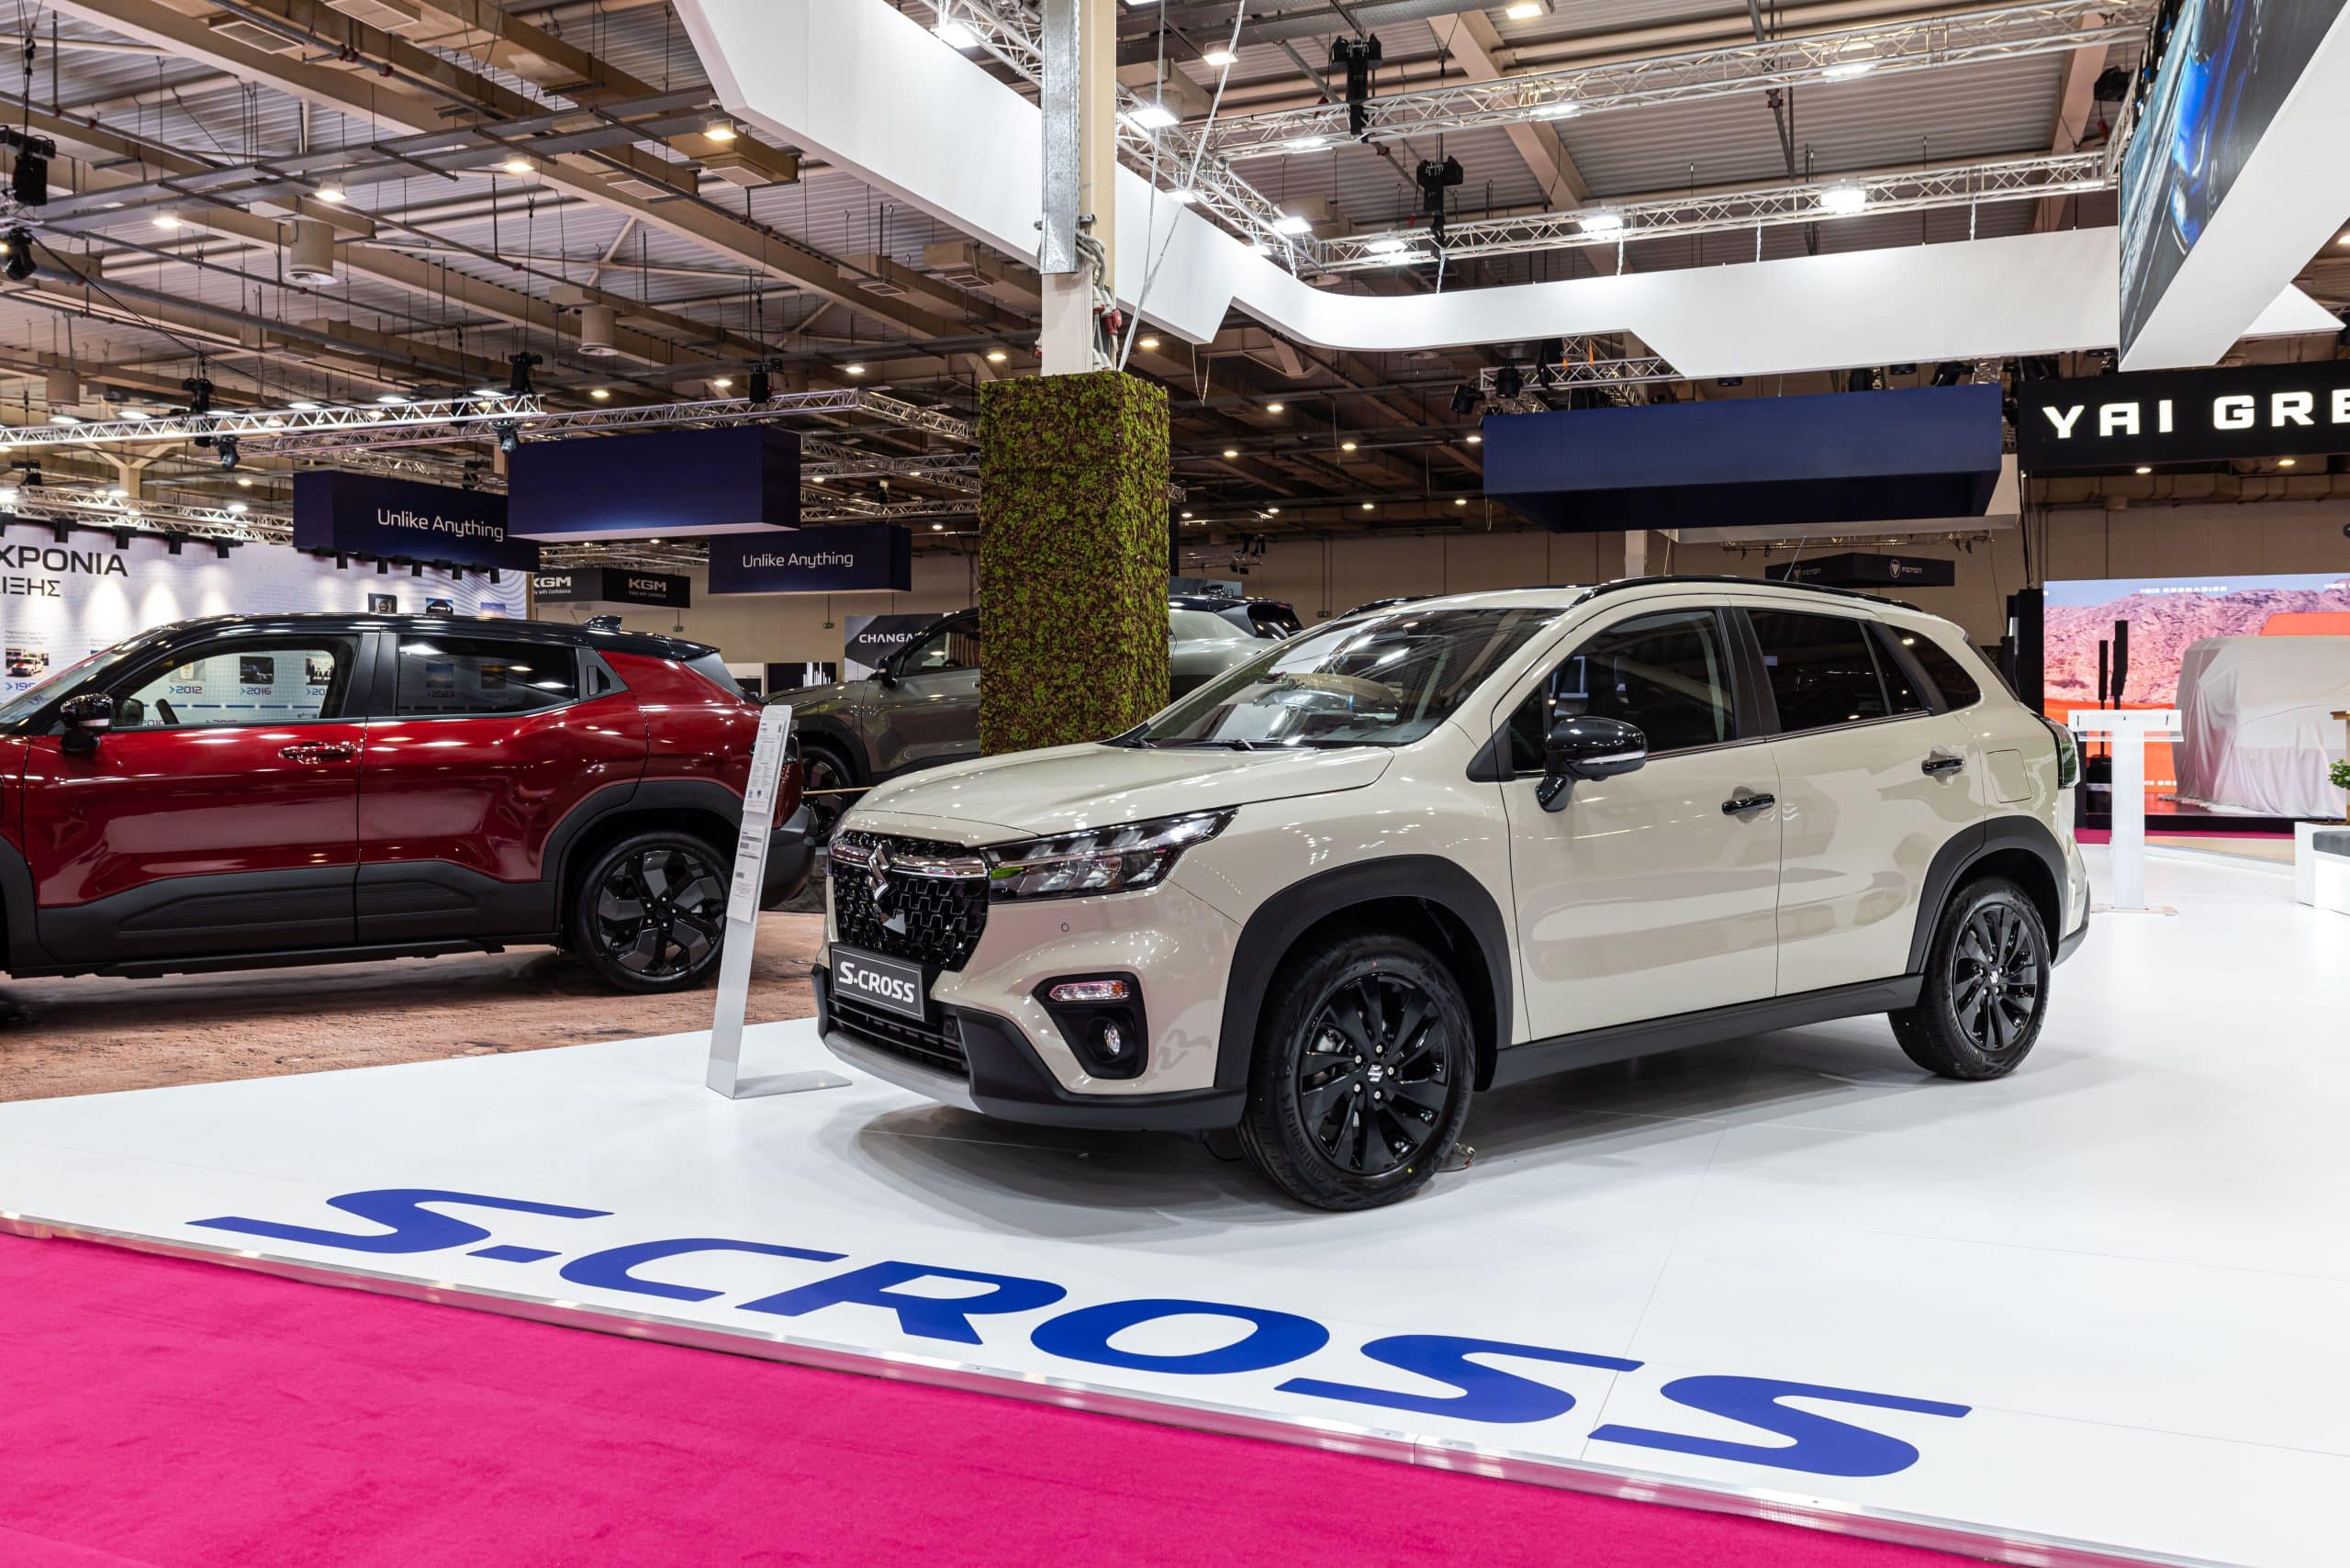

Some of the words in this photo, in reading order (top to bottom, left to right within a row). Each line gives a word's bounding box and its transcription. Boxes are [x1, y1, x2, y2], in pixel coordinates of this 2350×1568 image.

[2042, 399, 2173, 439] YAI
[377, 508, 429, 530] Unlike
[432, 515, 504, 543] Anything
[743, 553, 785, 567] Unlike
[788, 551, 854, 568] Anything
[0, 577, 61, 597] ΙΞΗΣ
[629, 578, 667, 592] KGM
[859, 633, 914, 643] CHANGA
[175, 686, 203, 694] 2012
[246, 687, 272, 695] 2016
[191, 1189, 1972, 1477] S-CROSS
